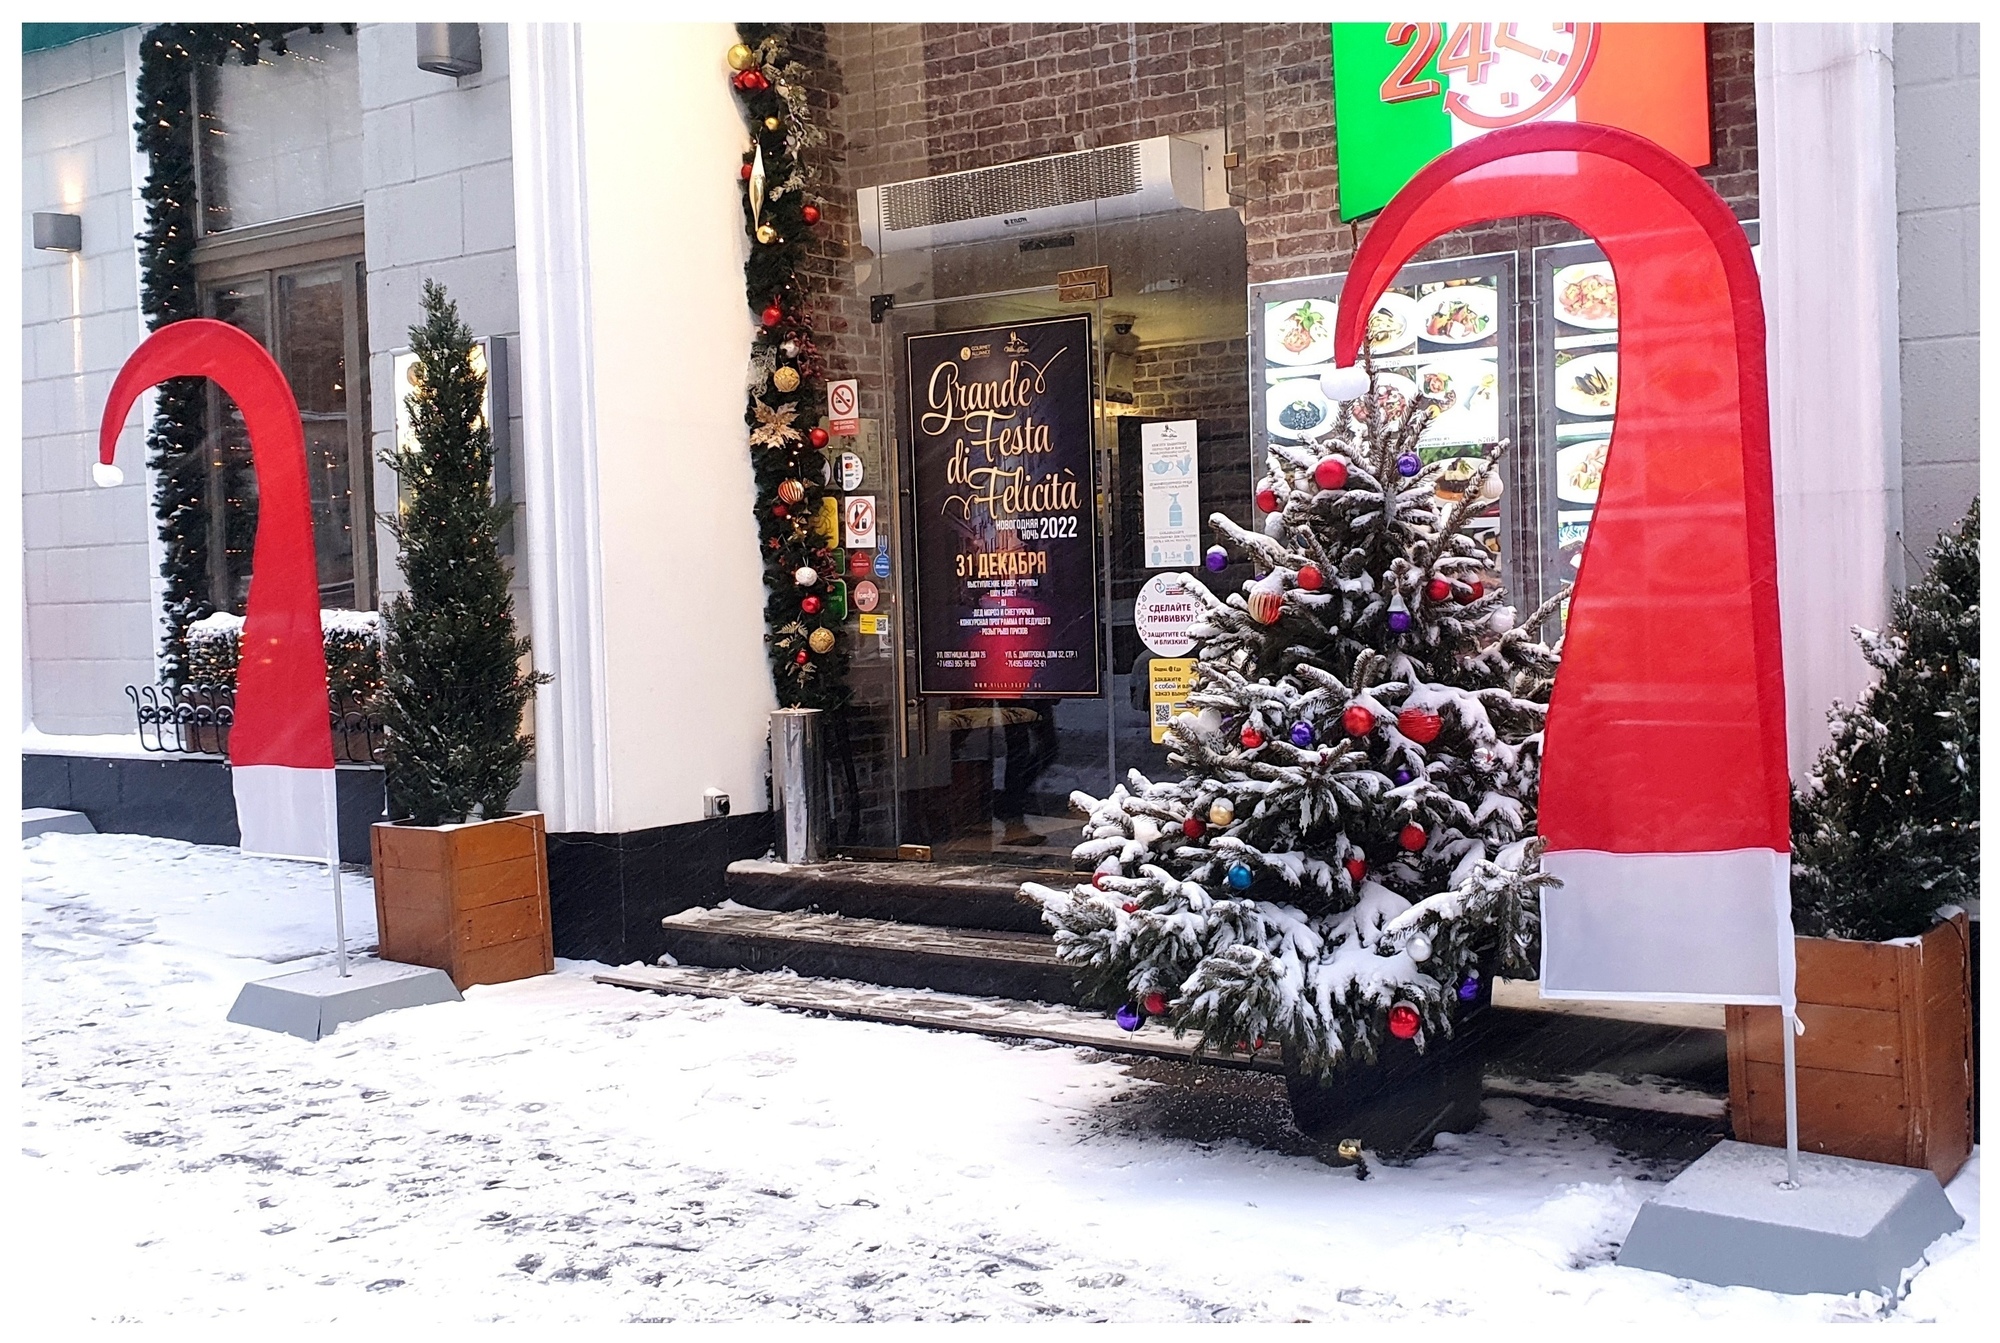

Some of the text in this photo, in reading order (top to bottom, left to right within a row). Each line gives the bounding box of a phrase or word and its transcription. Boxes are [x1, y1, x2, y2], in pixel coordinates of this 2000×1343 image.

[1380, 22, 1499, 104] 24
[921, 359, 1034, 436] Grande
[965, 409, 1055, 463] Festa
[946, 438, 971, 485] di
[967, 465, 1082, 520] Felicità
[995, 518, 1039, 530] НОВОГОДНЯЯ
[1040, 515, 1078, 539] 2022
[1021, 529, 1040, 540] НОЧЬ
[955, 551, 1047, 579] 31 ДЕКАБРЯ
[967, 581, 1000, 589] ВЫСТУПЛЕНИЕ
[1001, 580, 1016, 588] КАВЕР
[1001, 588, 1017, 597] БАЛЕТ
[984, 608, 1000, 616] МОРОЗ
[1004, 607, 1035, 616] СНЕГУРОЧКА
[1148, 602, 1191, 614] СДЕЛАЙТЕ
[960, 618, 989, 627] КОНКУРСНАЯ
[989, 618, 1018, 626] ПРОГРАММА
[1025, 617, 1052, 626] ВЕДУЩЕГО
[1147, 614, 1194, 623] ПРИВИВКУ!
[981, 627, 1029, 636] РОЗЫГРЫШ ПРИЗОВ
[970, 651, 980, 659] ДОМ
[1047, 650, 1058, 659] ДОМ
